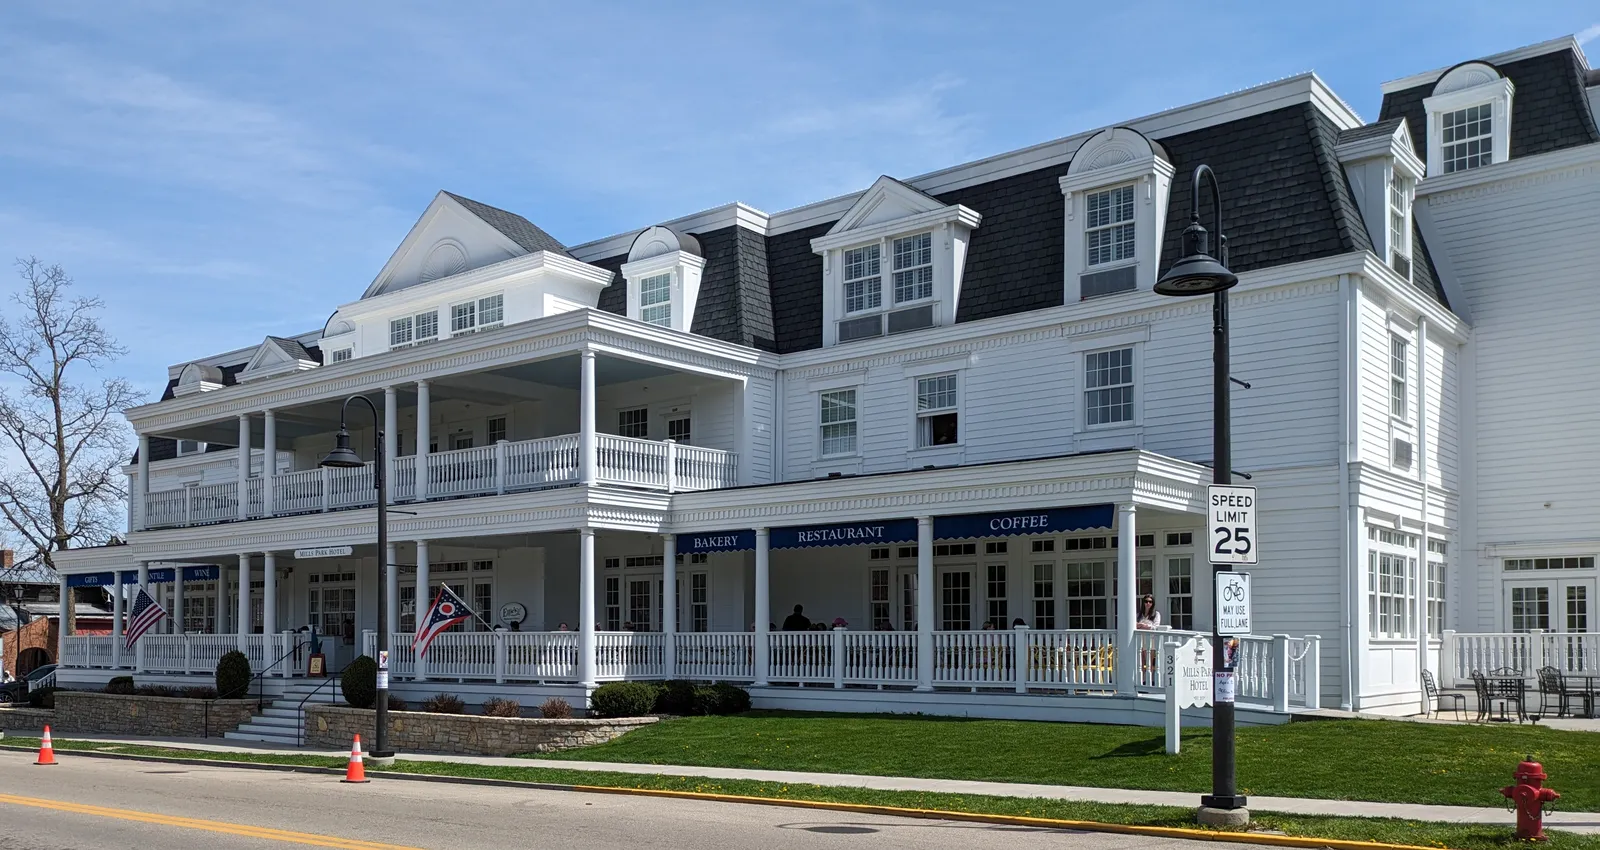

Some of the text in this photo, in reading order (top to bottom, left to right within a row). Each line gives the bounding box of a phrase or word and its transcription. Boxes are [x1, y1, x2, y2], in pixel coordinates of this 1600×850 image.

[1212, 494, 1252, 508] SPEED
[990, 514, 1049, 531] COFFEE
[1216, 510, 1248, 523] LIMIT
[797, 526, 885, 543] RESTAURANT
[1214, 526, 1252, 555] 25
[694, 535, 738, 549] BAKERY
[194, 568, 210, 577] WINE
[84, 575, 98, 584] GIFTS
[1222, 605, 1246, 615] MAY USE
[1220, 618, 1249, 628] FULL LANE
[1183, 666, 1200, 678] MILLS
[1189, 680, 1209, 691] HOTEL
